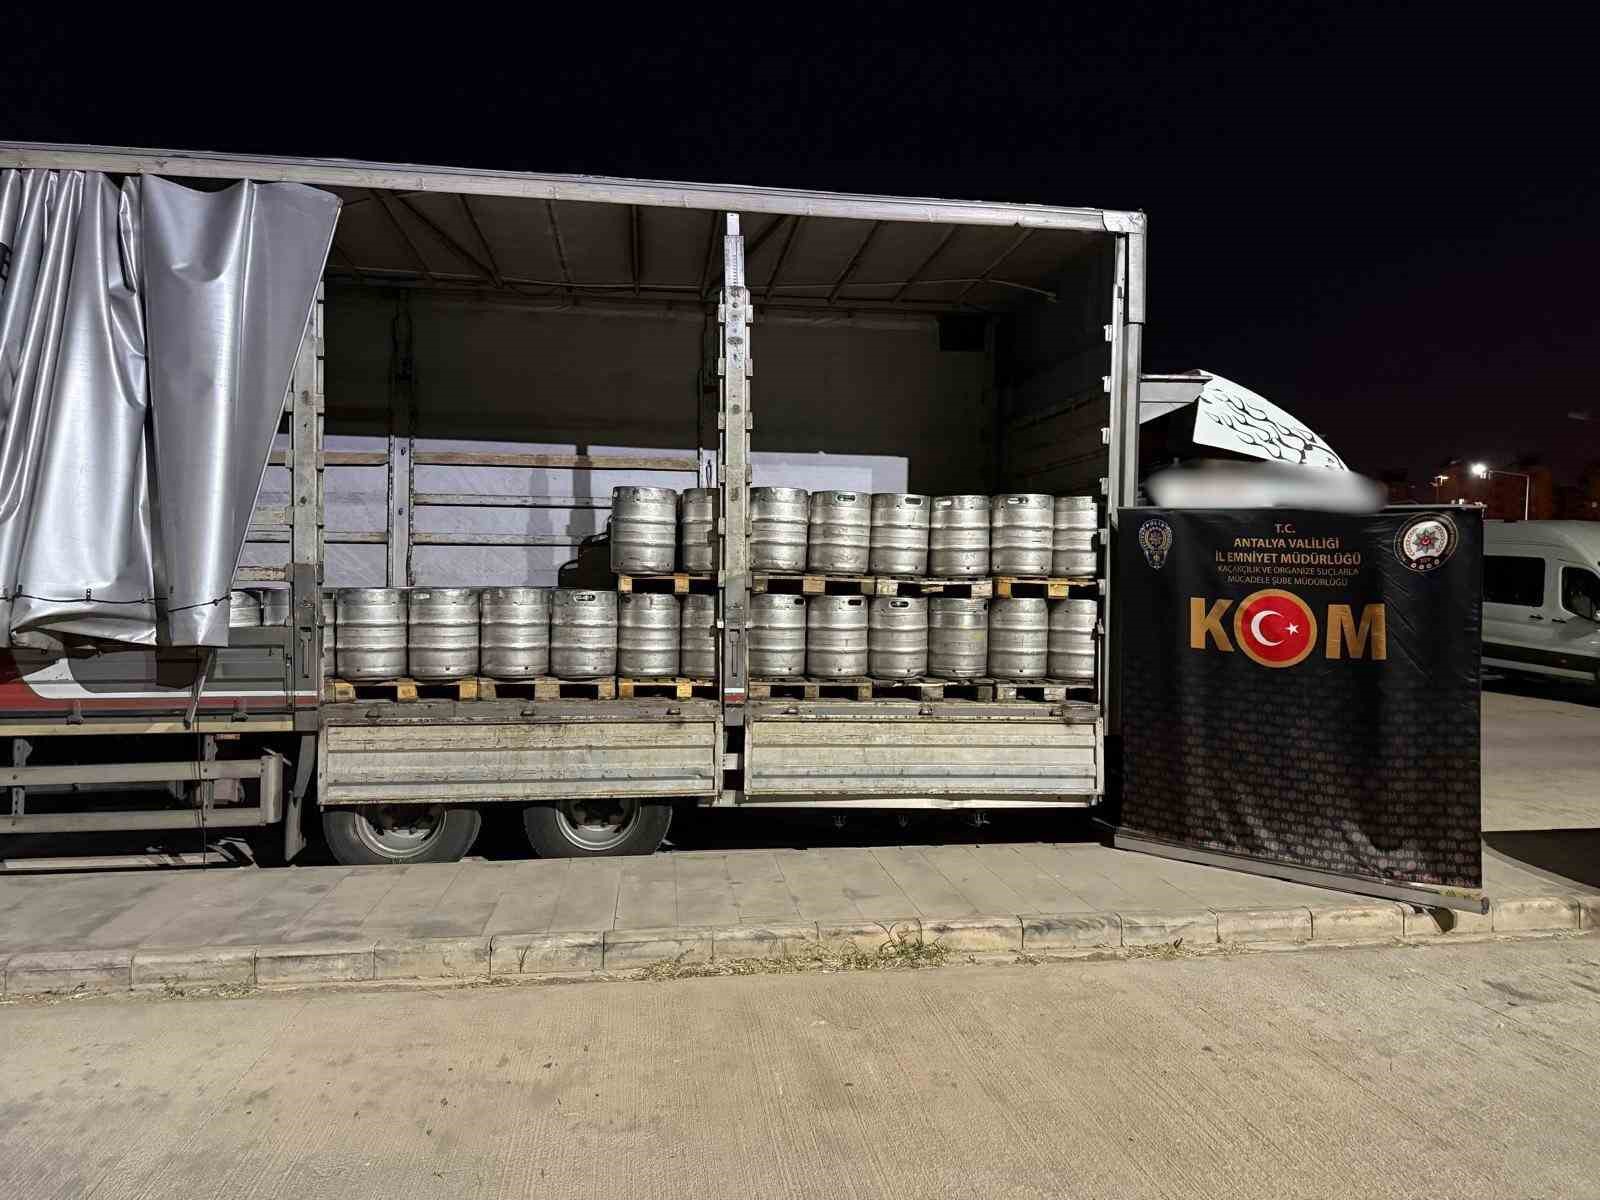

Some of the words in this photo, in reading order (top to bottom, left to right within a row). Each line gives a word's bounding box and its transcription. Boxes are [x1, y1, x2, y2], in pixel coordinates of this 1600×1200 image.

[1274, 523, 1296, 534] T.C.
[1234, 537, 1286, 549] ANTALYA
[1215, 550, 1227, 562] İL
[1227, 550, 1278, 563] EMNİYET
[1280, 551, 1361, 565] MÜDÜRLÜĞÜ
